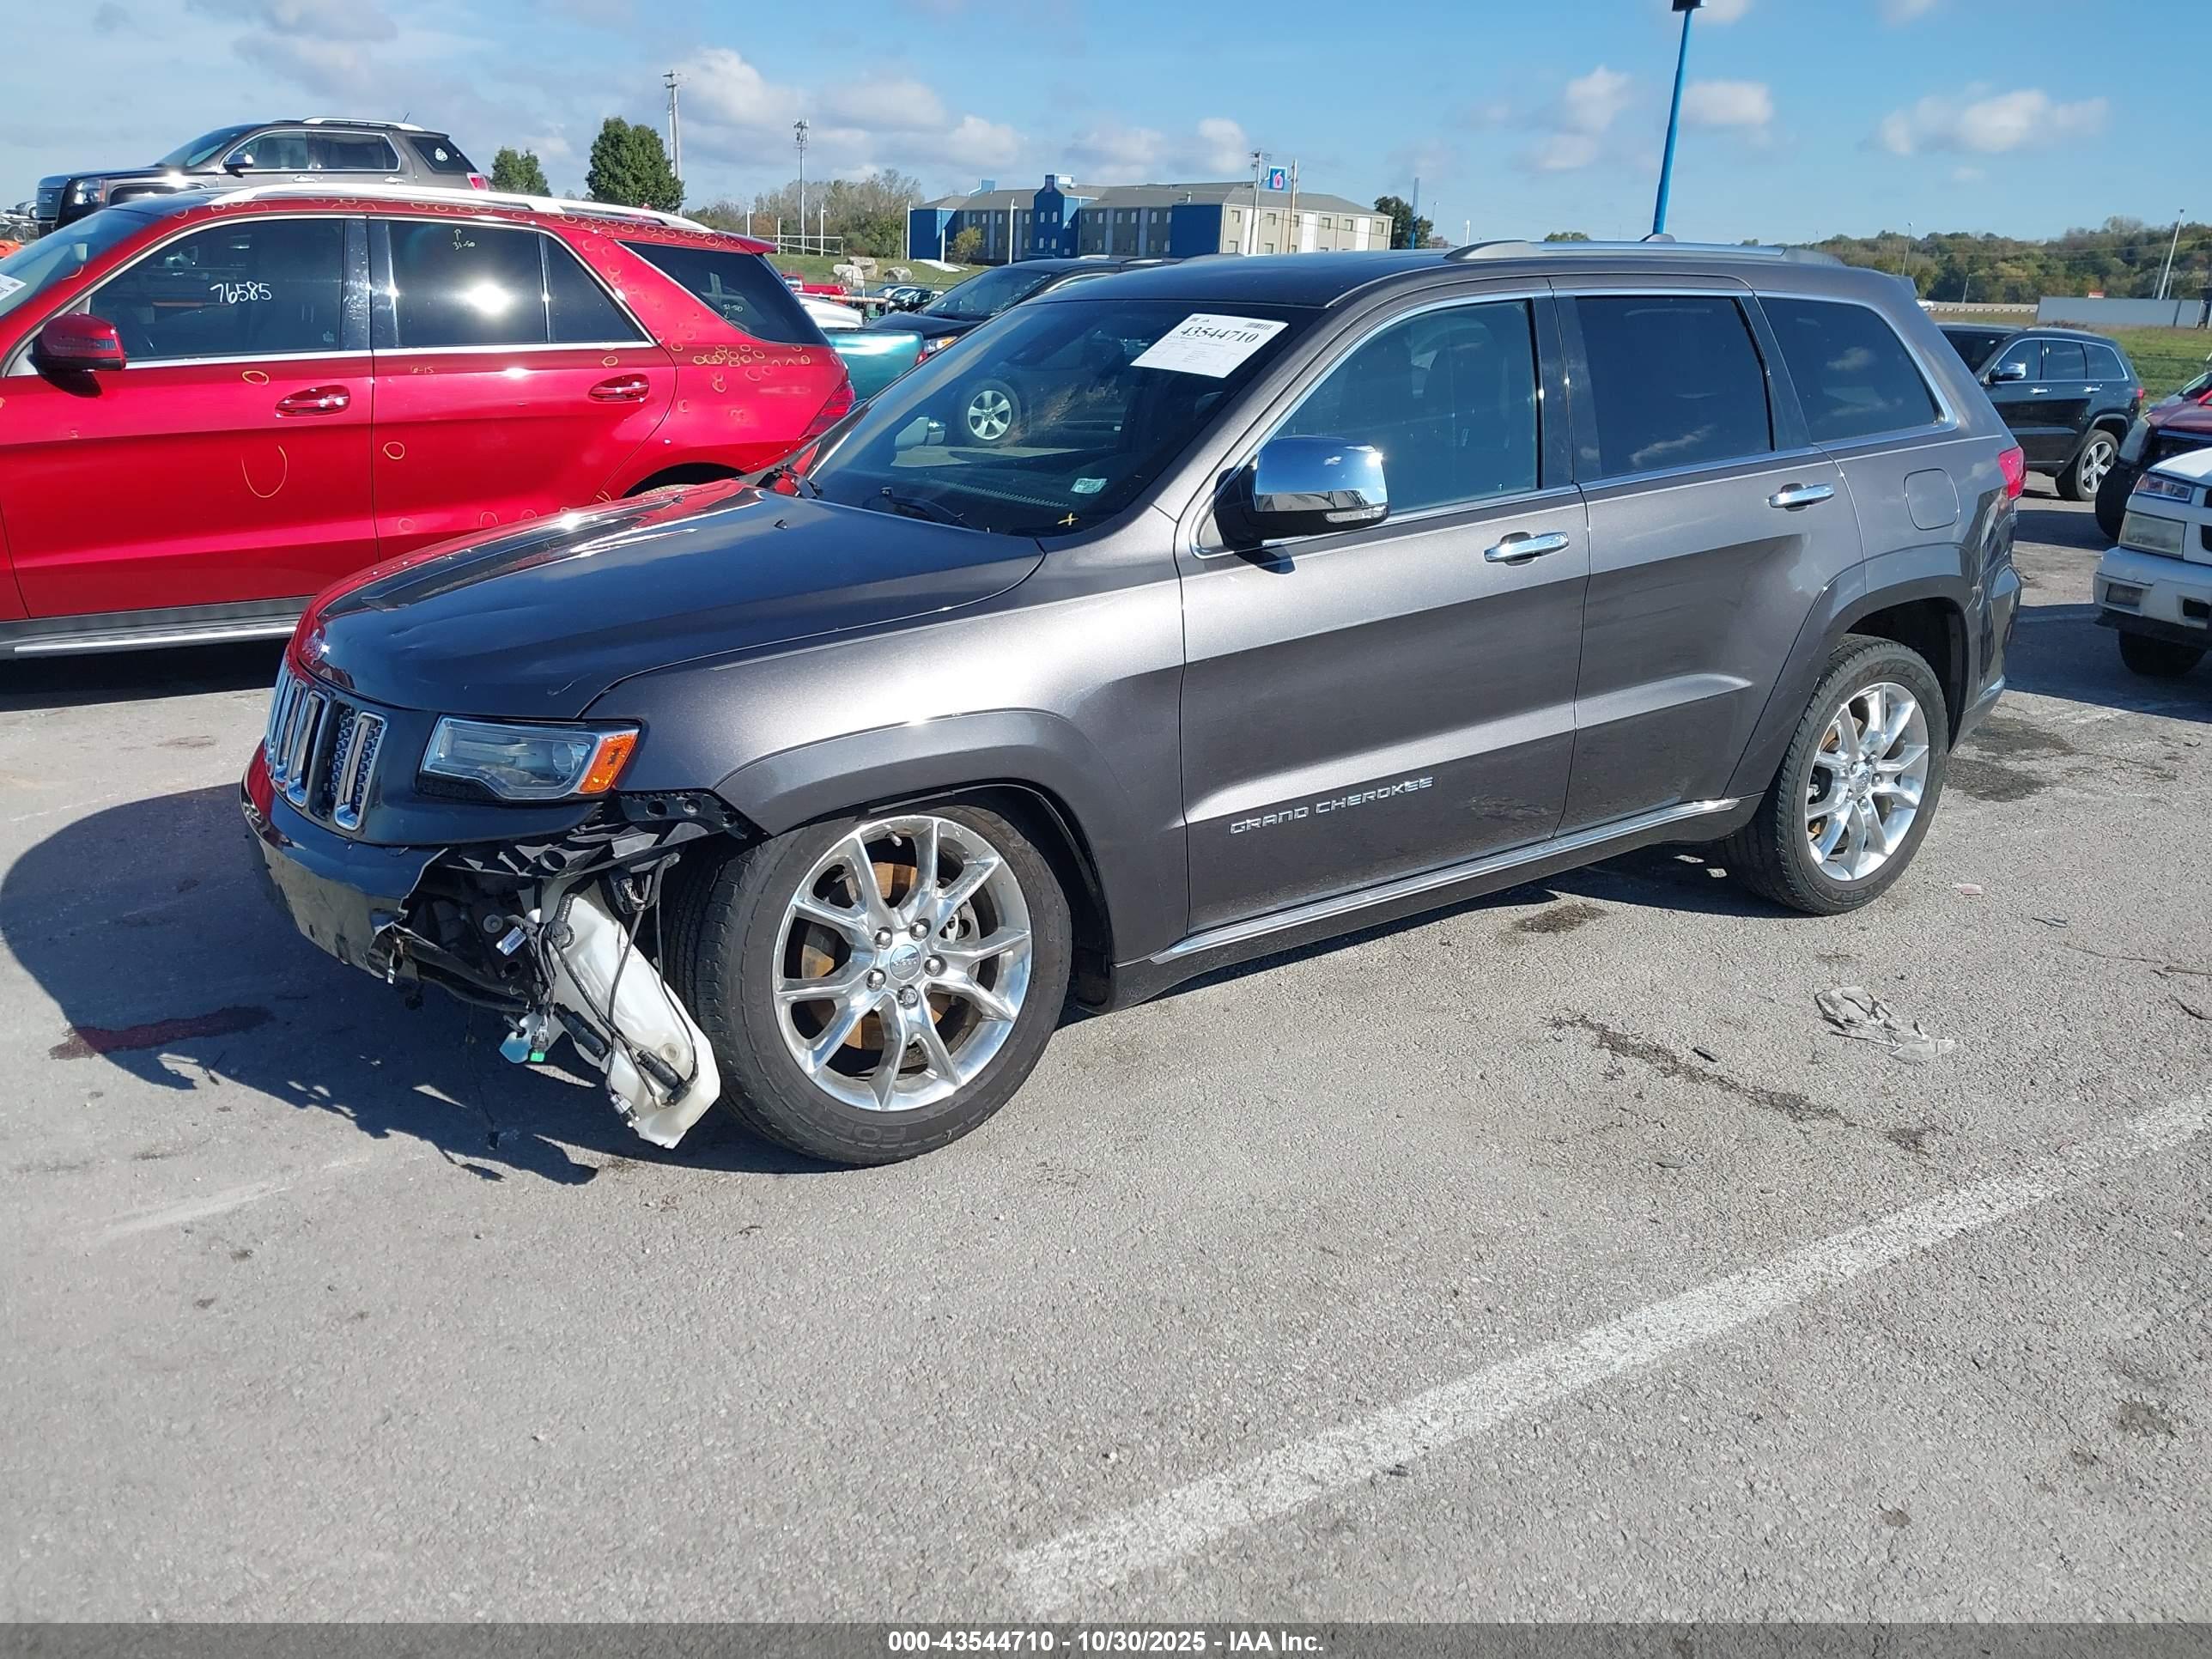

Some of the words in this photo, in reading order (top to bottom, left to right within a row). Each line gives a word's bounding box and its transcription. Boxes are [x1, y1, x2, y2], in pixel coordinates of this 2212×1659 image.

[210, 281, 272, 304] 76585
[1180, 325, 1260, 344] 43544710
[1230, 806, 1310, 835] GRAND
[1315, 776, 1433, 814] CHEROKEE
